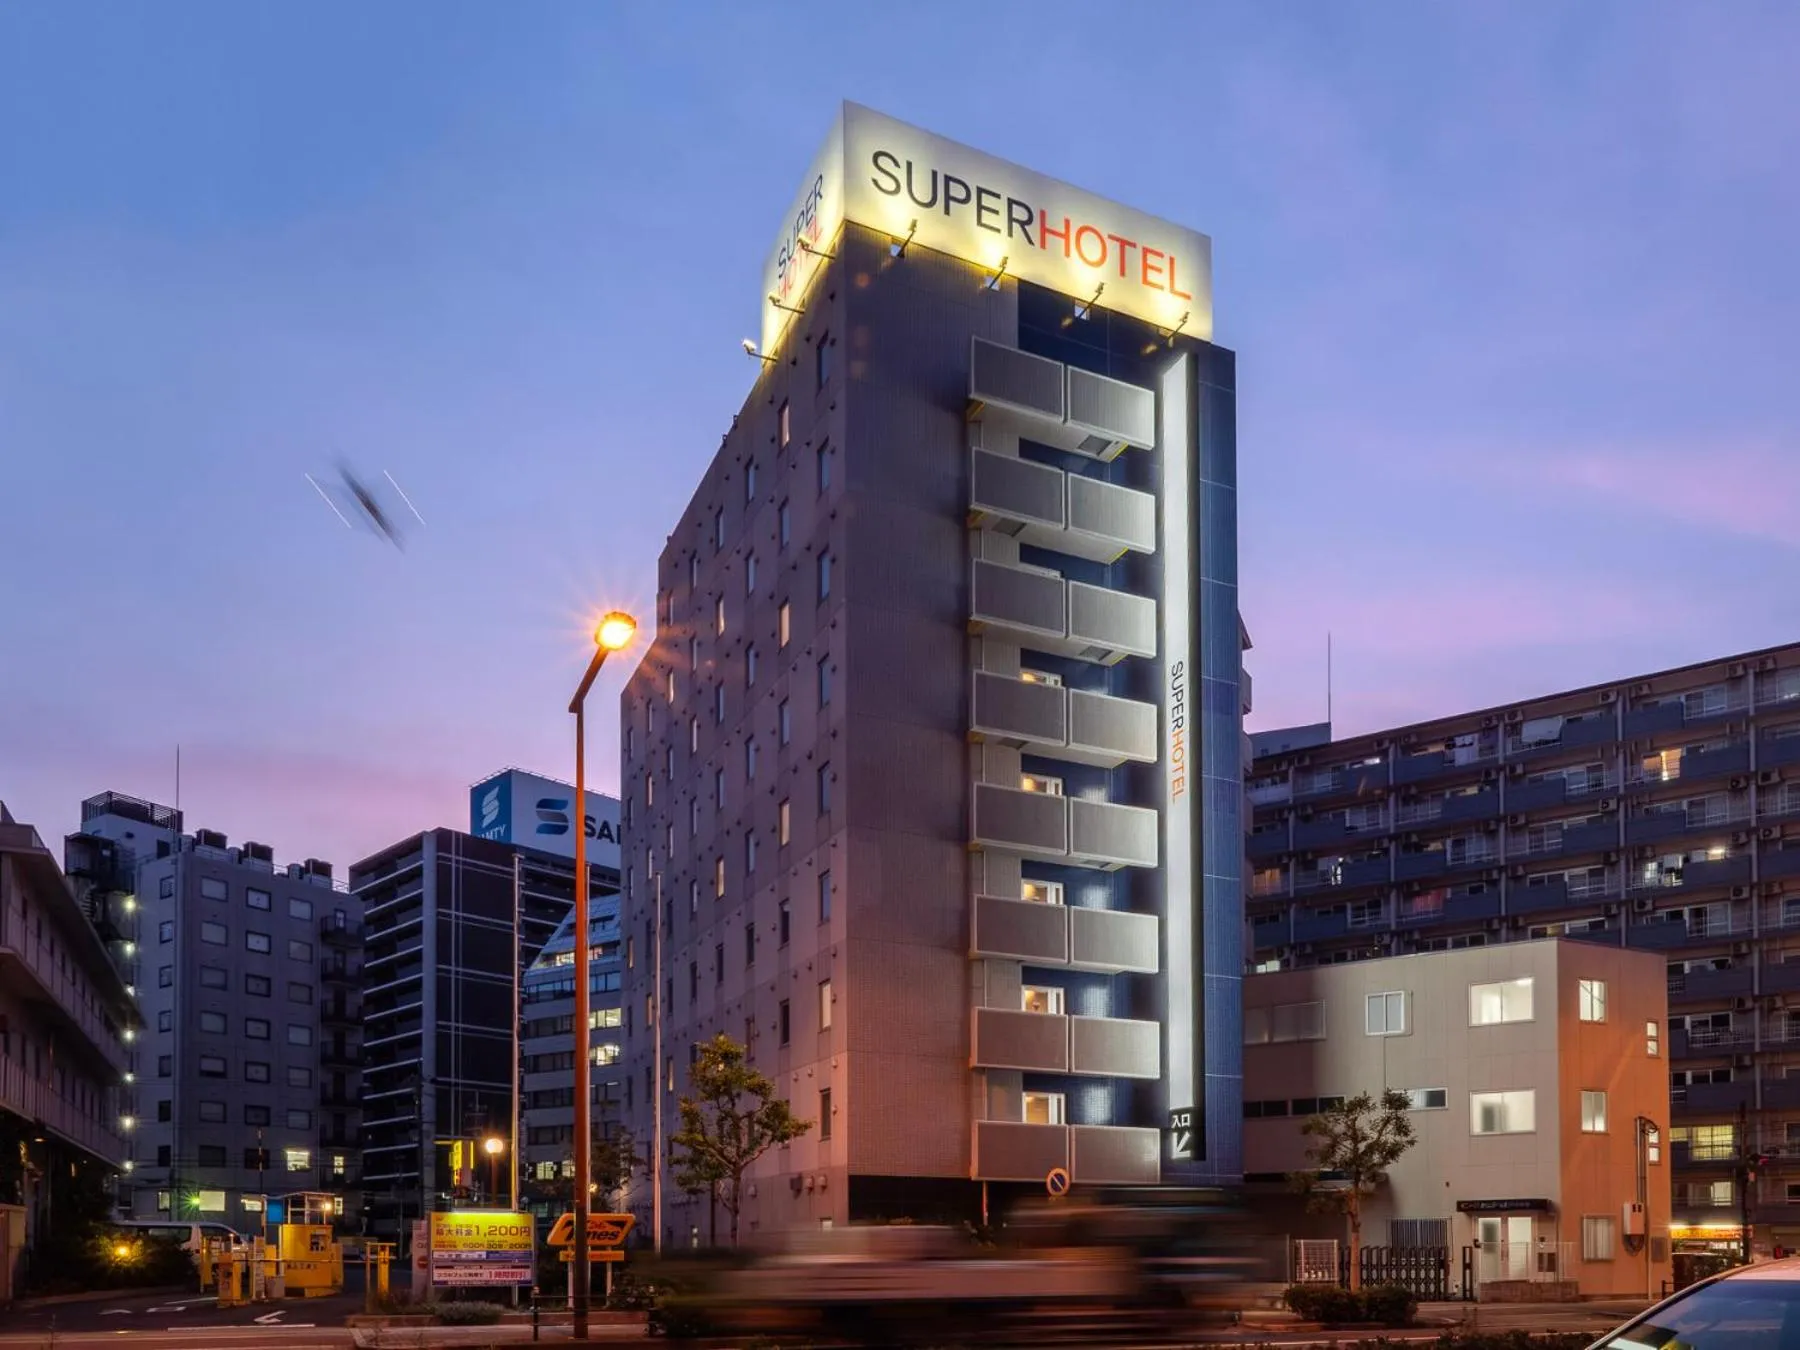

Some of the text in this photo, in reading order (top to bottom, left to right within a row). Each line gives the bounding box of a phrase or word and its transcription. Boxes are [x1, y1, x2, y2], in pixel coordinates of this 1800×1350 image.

[778, 174, 823, 279] SUPER
[584, 815, 621, 845] SA
[1171, 1113, 1191, 1129] 入口
